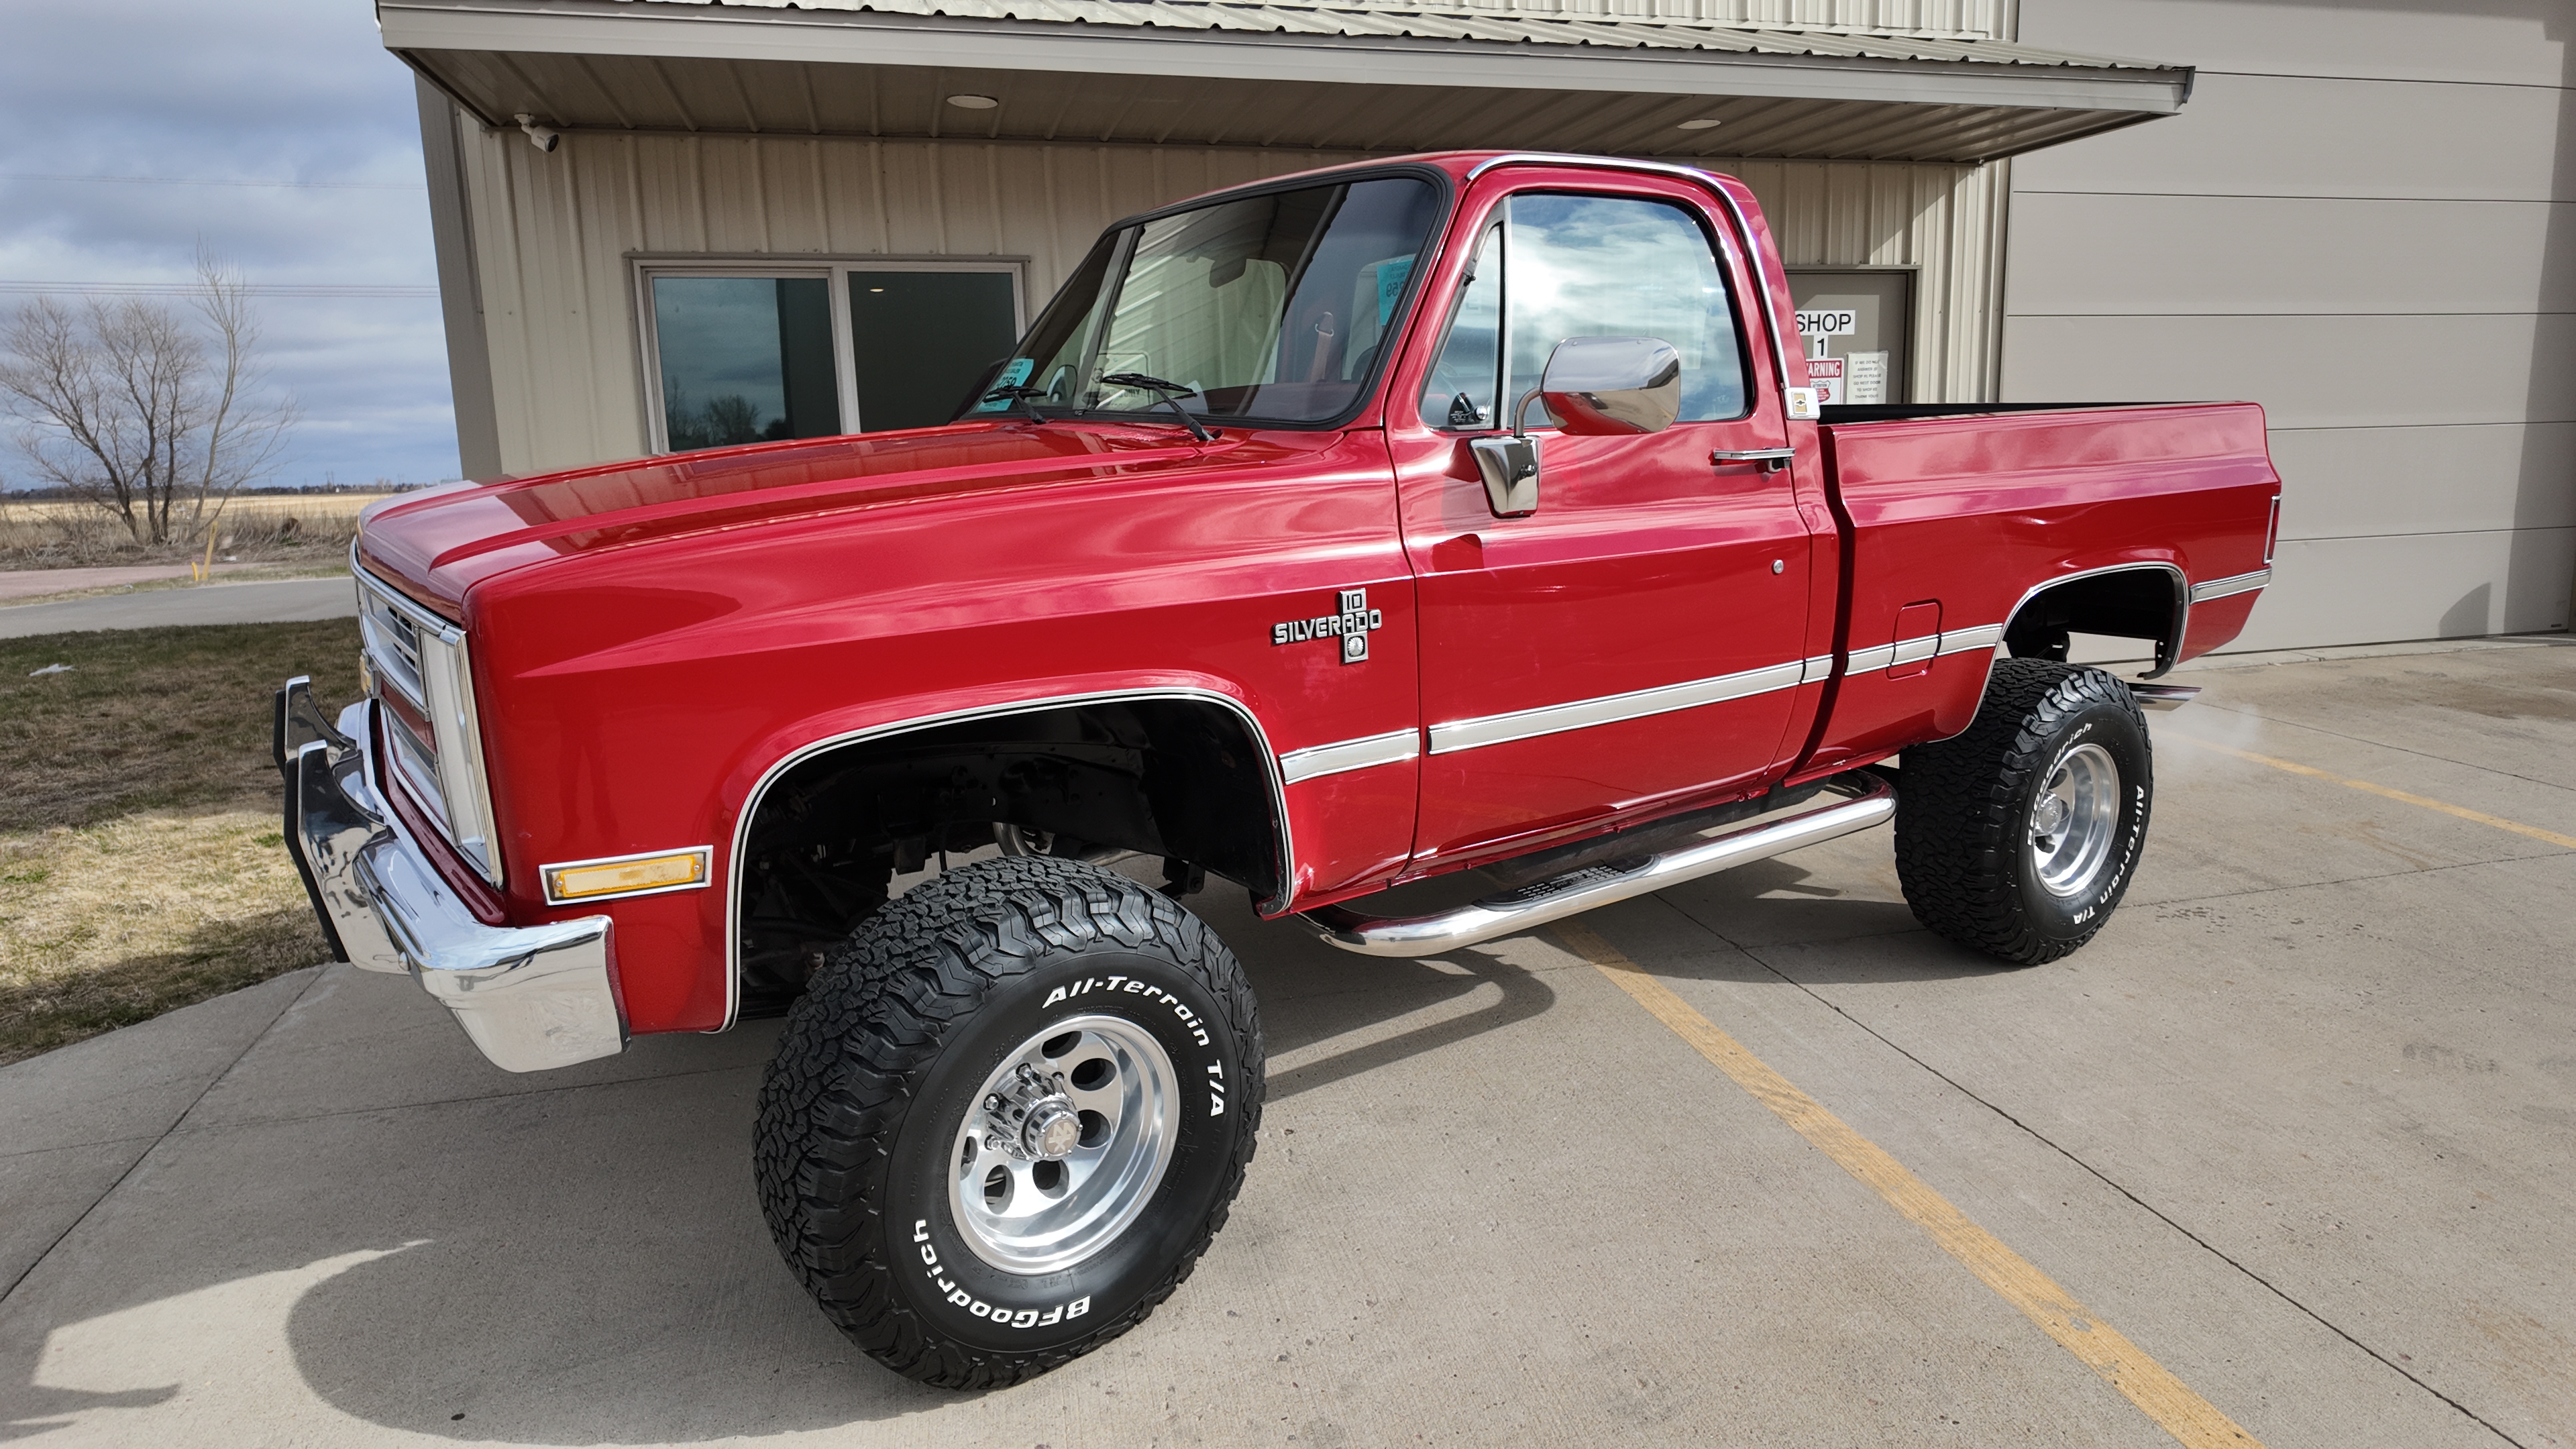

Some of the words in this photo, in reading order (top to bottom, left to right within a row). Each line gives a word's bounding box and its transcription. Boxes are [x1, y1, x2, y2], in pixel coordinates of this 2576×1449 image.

[1796, 313, 1851, 332] SHOP
[1817, 337, 1825, 356] 1
[1806, 362, 1840, 377] ARNING
[1346, 593, 1362, 610] 10
[1274, 608, 1382, 645] SILVERADO
[2100, 785, 2144, 904] All-Terrain
[2074, 906, 2096, 924] T/A
[1042, 975, 1210, 1046] All-Terrain
[1207, 1059, 1224, 1117] T/A
[913, 1219, 1091, 1328] BFGoodrich
